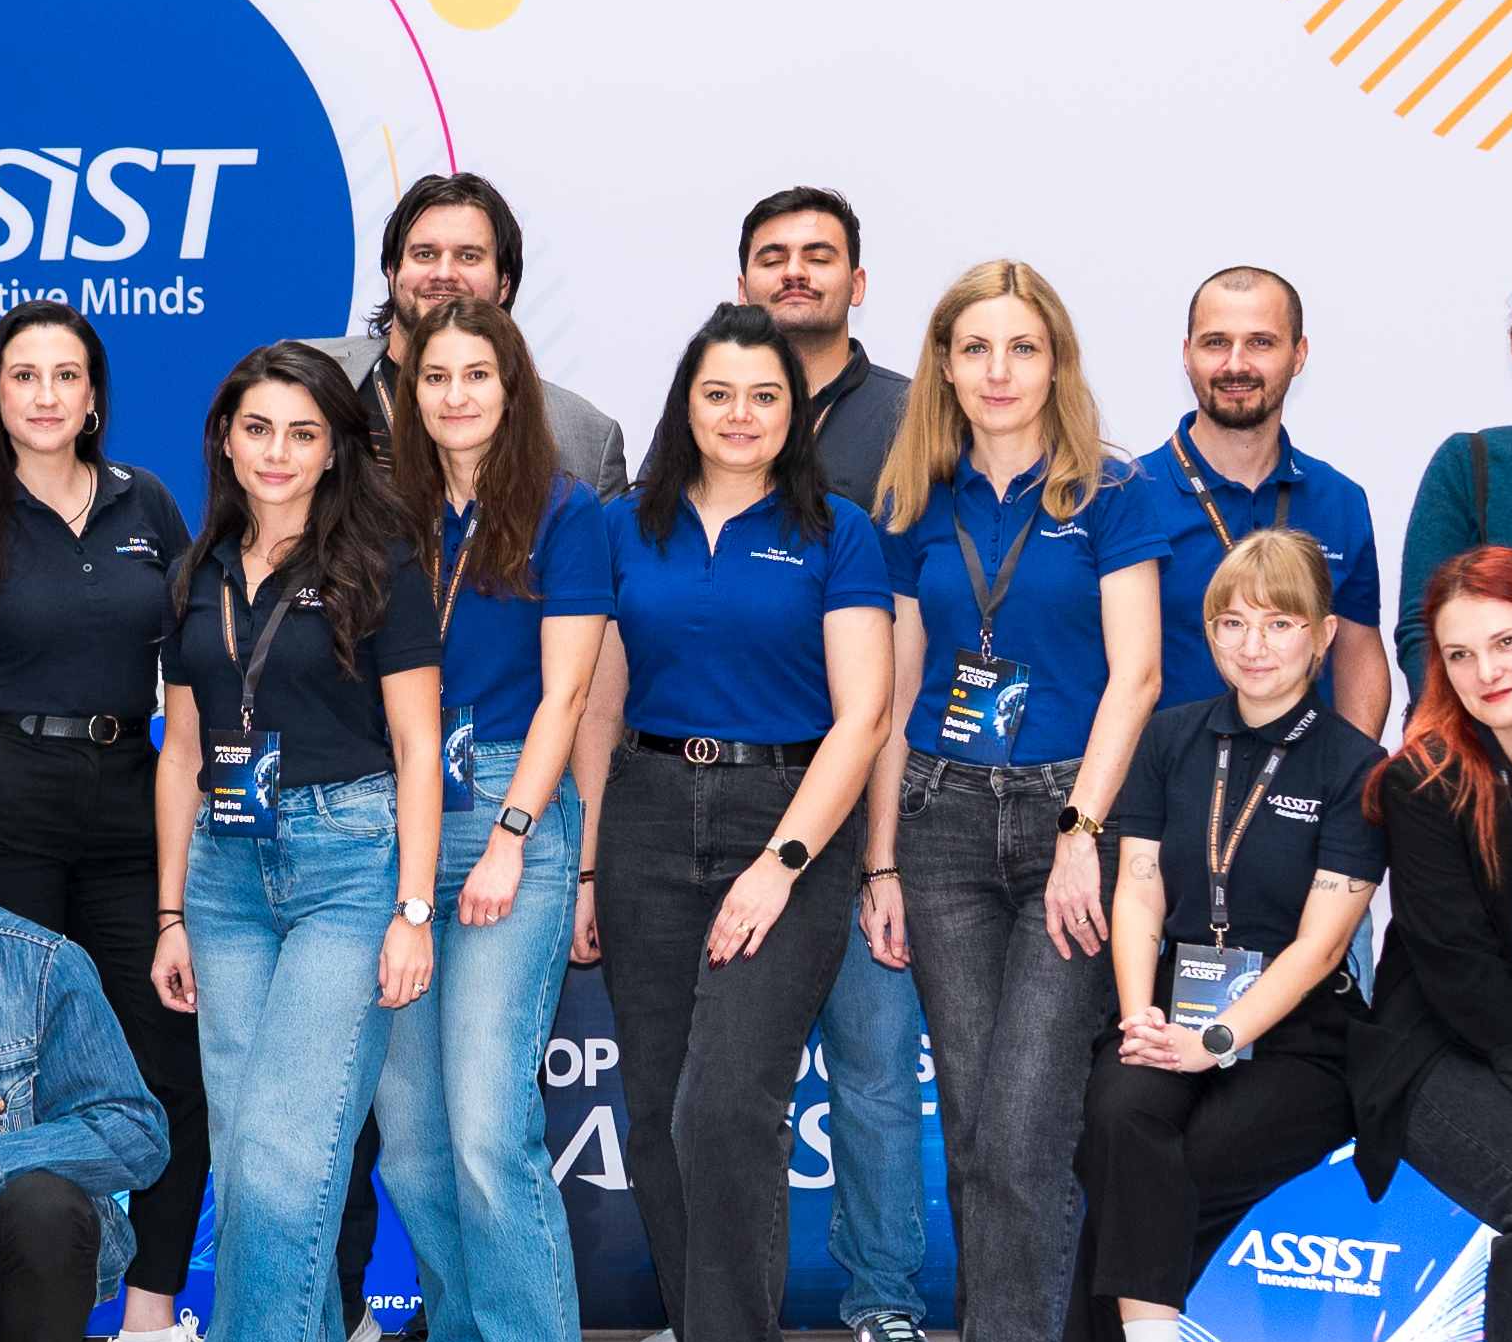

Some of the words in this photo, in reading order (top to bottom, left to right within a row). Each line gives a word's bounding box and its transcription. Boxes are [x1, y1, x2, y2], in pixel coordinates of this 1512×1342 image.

[80, 275, 206, 316] Minds
[957, 672, 998, 689] ASSIST
[944, 716, 982, 734] Daniela
[215, 752, 251, 764] ASSIST
[1179, 967, 1228, 982] ASSIST
[1227, 1229, 1401, 1282] ASSIST
[1257, 1269, 1333, 1293] Innovative
[1334, 1277, 1382, 1297] Minds
